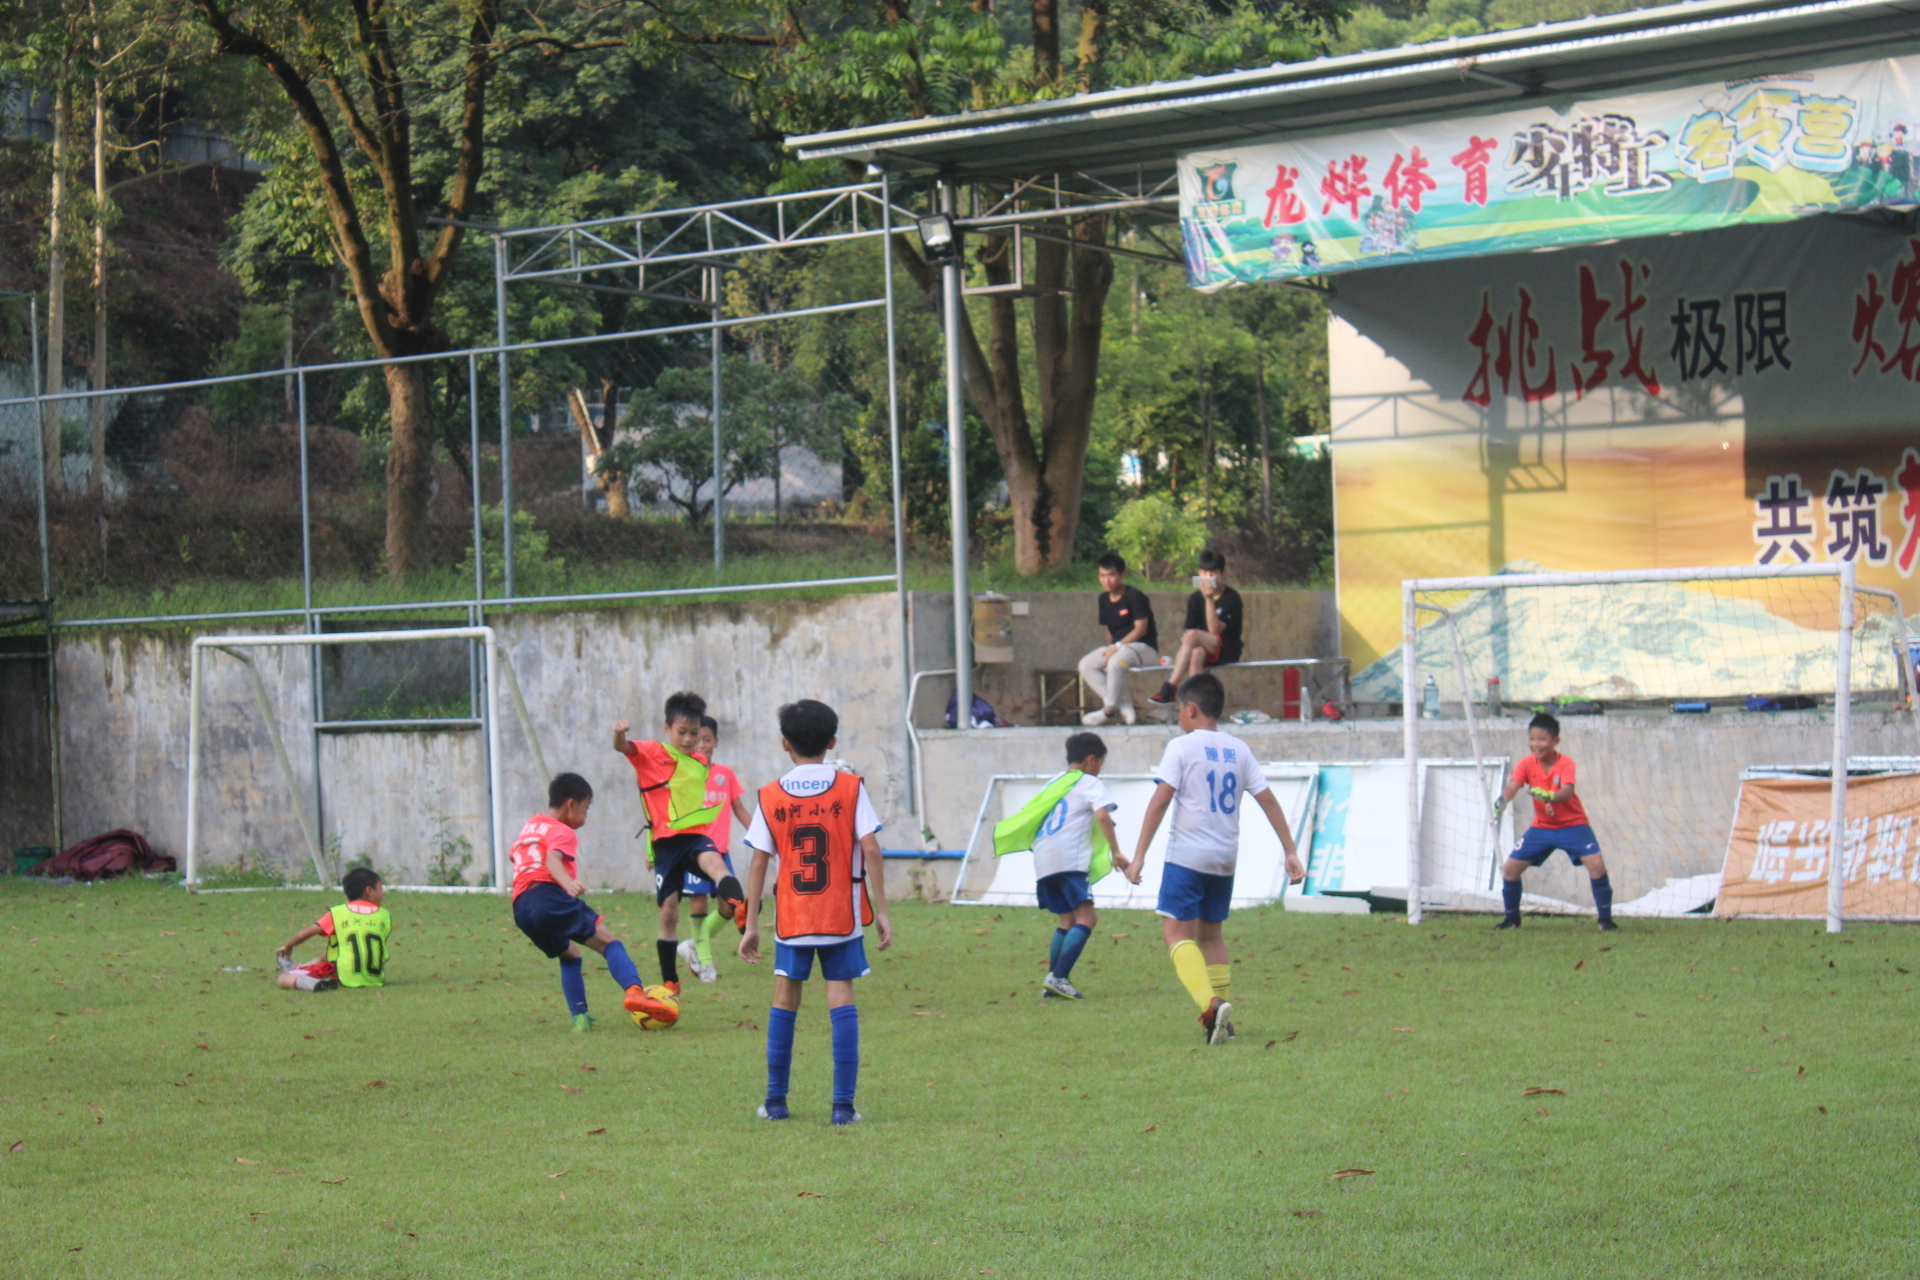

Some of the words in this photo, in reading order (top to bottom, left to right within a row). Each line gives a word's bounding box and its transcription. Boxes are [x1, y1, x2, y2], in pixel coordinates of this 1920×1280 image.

[1263, 134, 1498, 230] 龙烨体育
[1463, 259, 1791, 407] 挑战极限
[1035, 798, 1068, 839] 0
[1206, 770, 1237, 814] 18
[791, 823, 830, 895] 3
[347, 932, 383, 975] 10
